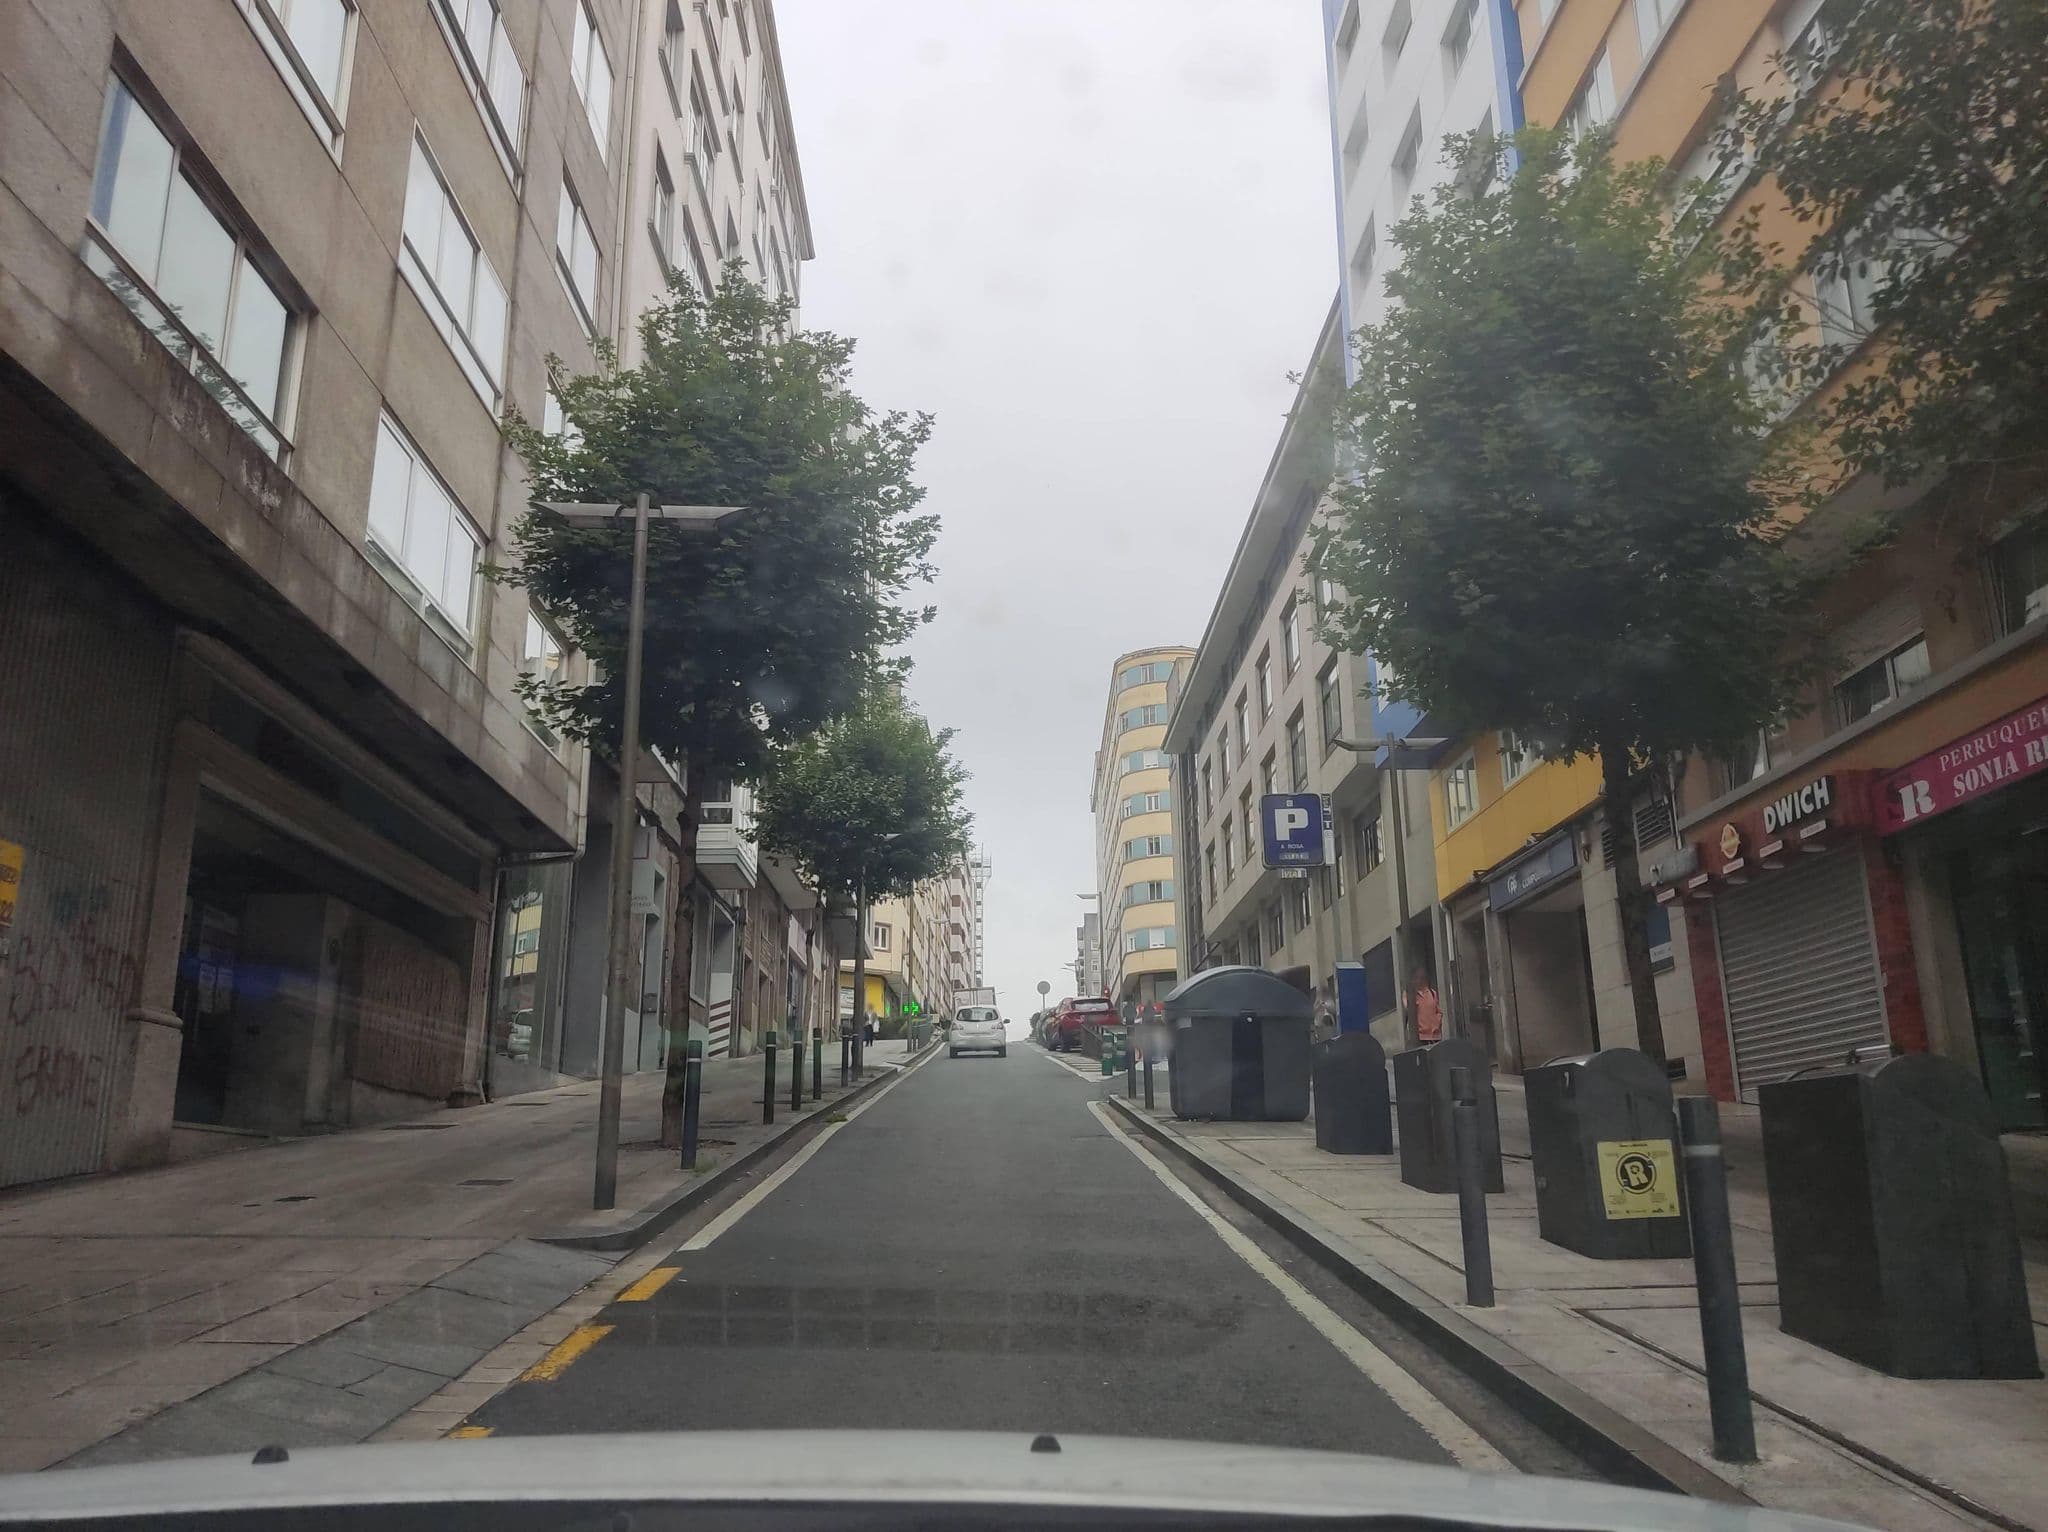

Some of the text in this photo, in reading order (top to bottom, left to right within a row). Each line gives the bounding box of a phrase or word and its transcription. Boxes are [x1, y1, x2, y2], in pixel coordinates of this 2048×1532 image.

[1953, 751, 2020, 798] SONIA
[1274, 808, 1309, 841] P
[1762, 776, 1831, 835] DWICH
